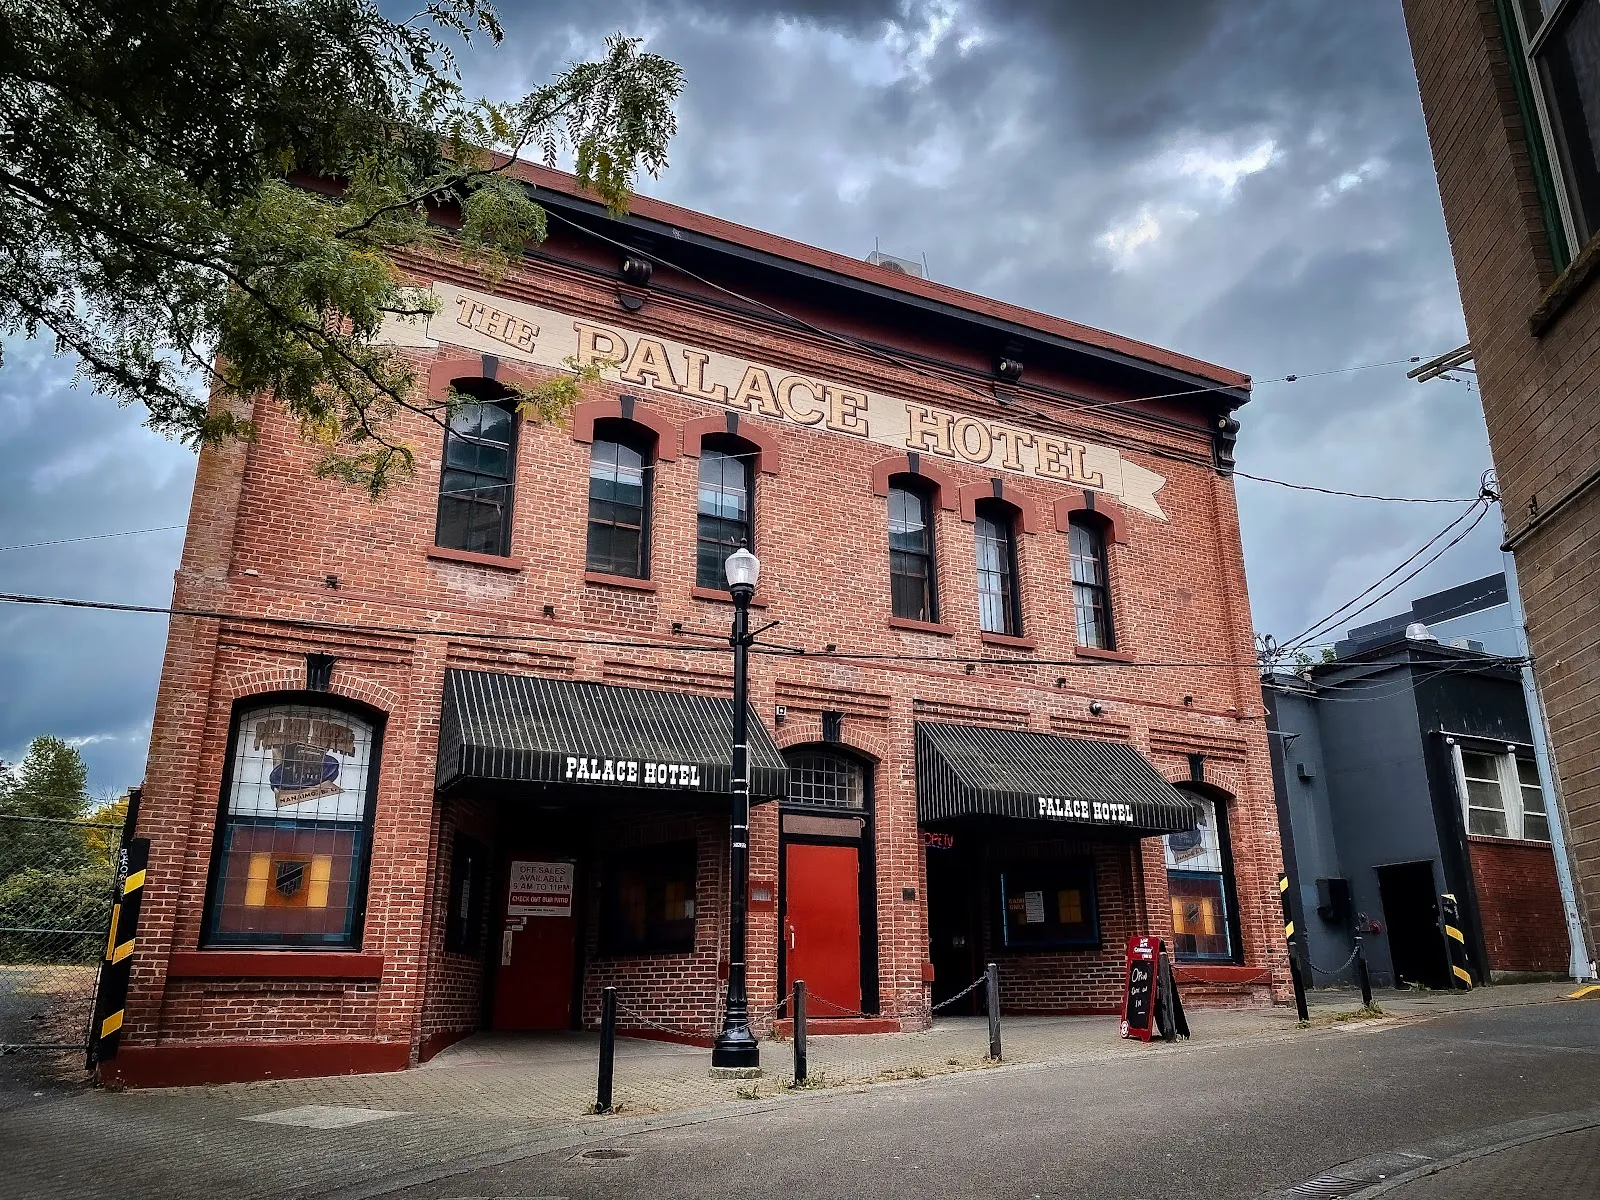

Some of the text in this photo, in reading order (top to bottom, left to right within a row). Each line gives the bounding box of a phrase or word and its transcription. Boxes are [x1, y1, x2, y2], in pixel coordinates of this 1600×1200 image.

[455, 293, 1104, 489] THE PALACE HOTEL
[565, 756, 701, 786] PALACE HOTEL
[1038, 797, 1133, 822] PALACE HOTEL
[519, 874, 565, 883] AVAILABLE
[520, 866, 566, 875] OFF SALES
[536, 883, 547, 891] TO
